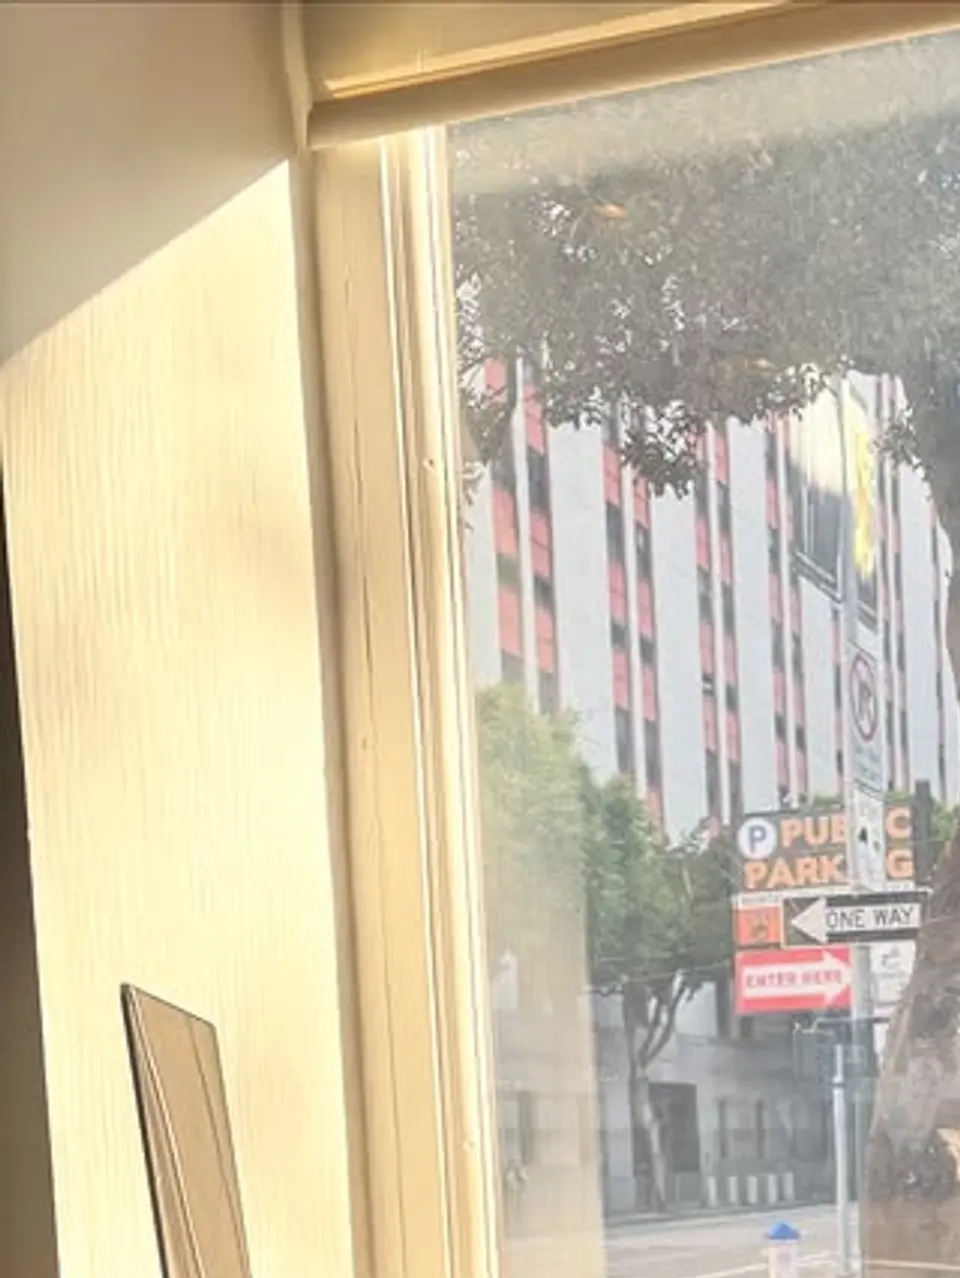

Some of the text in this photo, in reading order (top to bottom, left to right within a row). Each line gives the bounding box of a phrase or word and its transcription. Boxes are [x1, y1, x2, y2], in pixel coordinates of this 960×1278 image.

[780, 805, 913, 847] PUBC
[744, 848, 914, 889] PARKG
[826, 906, 914, 928] ONE WAY
[747, 969, 842, 987] ENTER HERE
